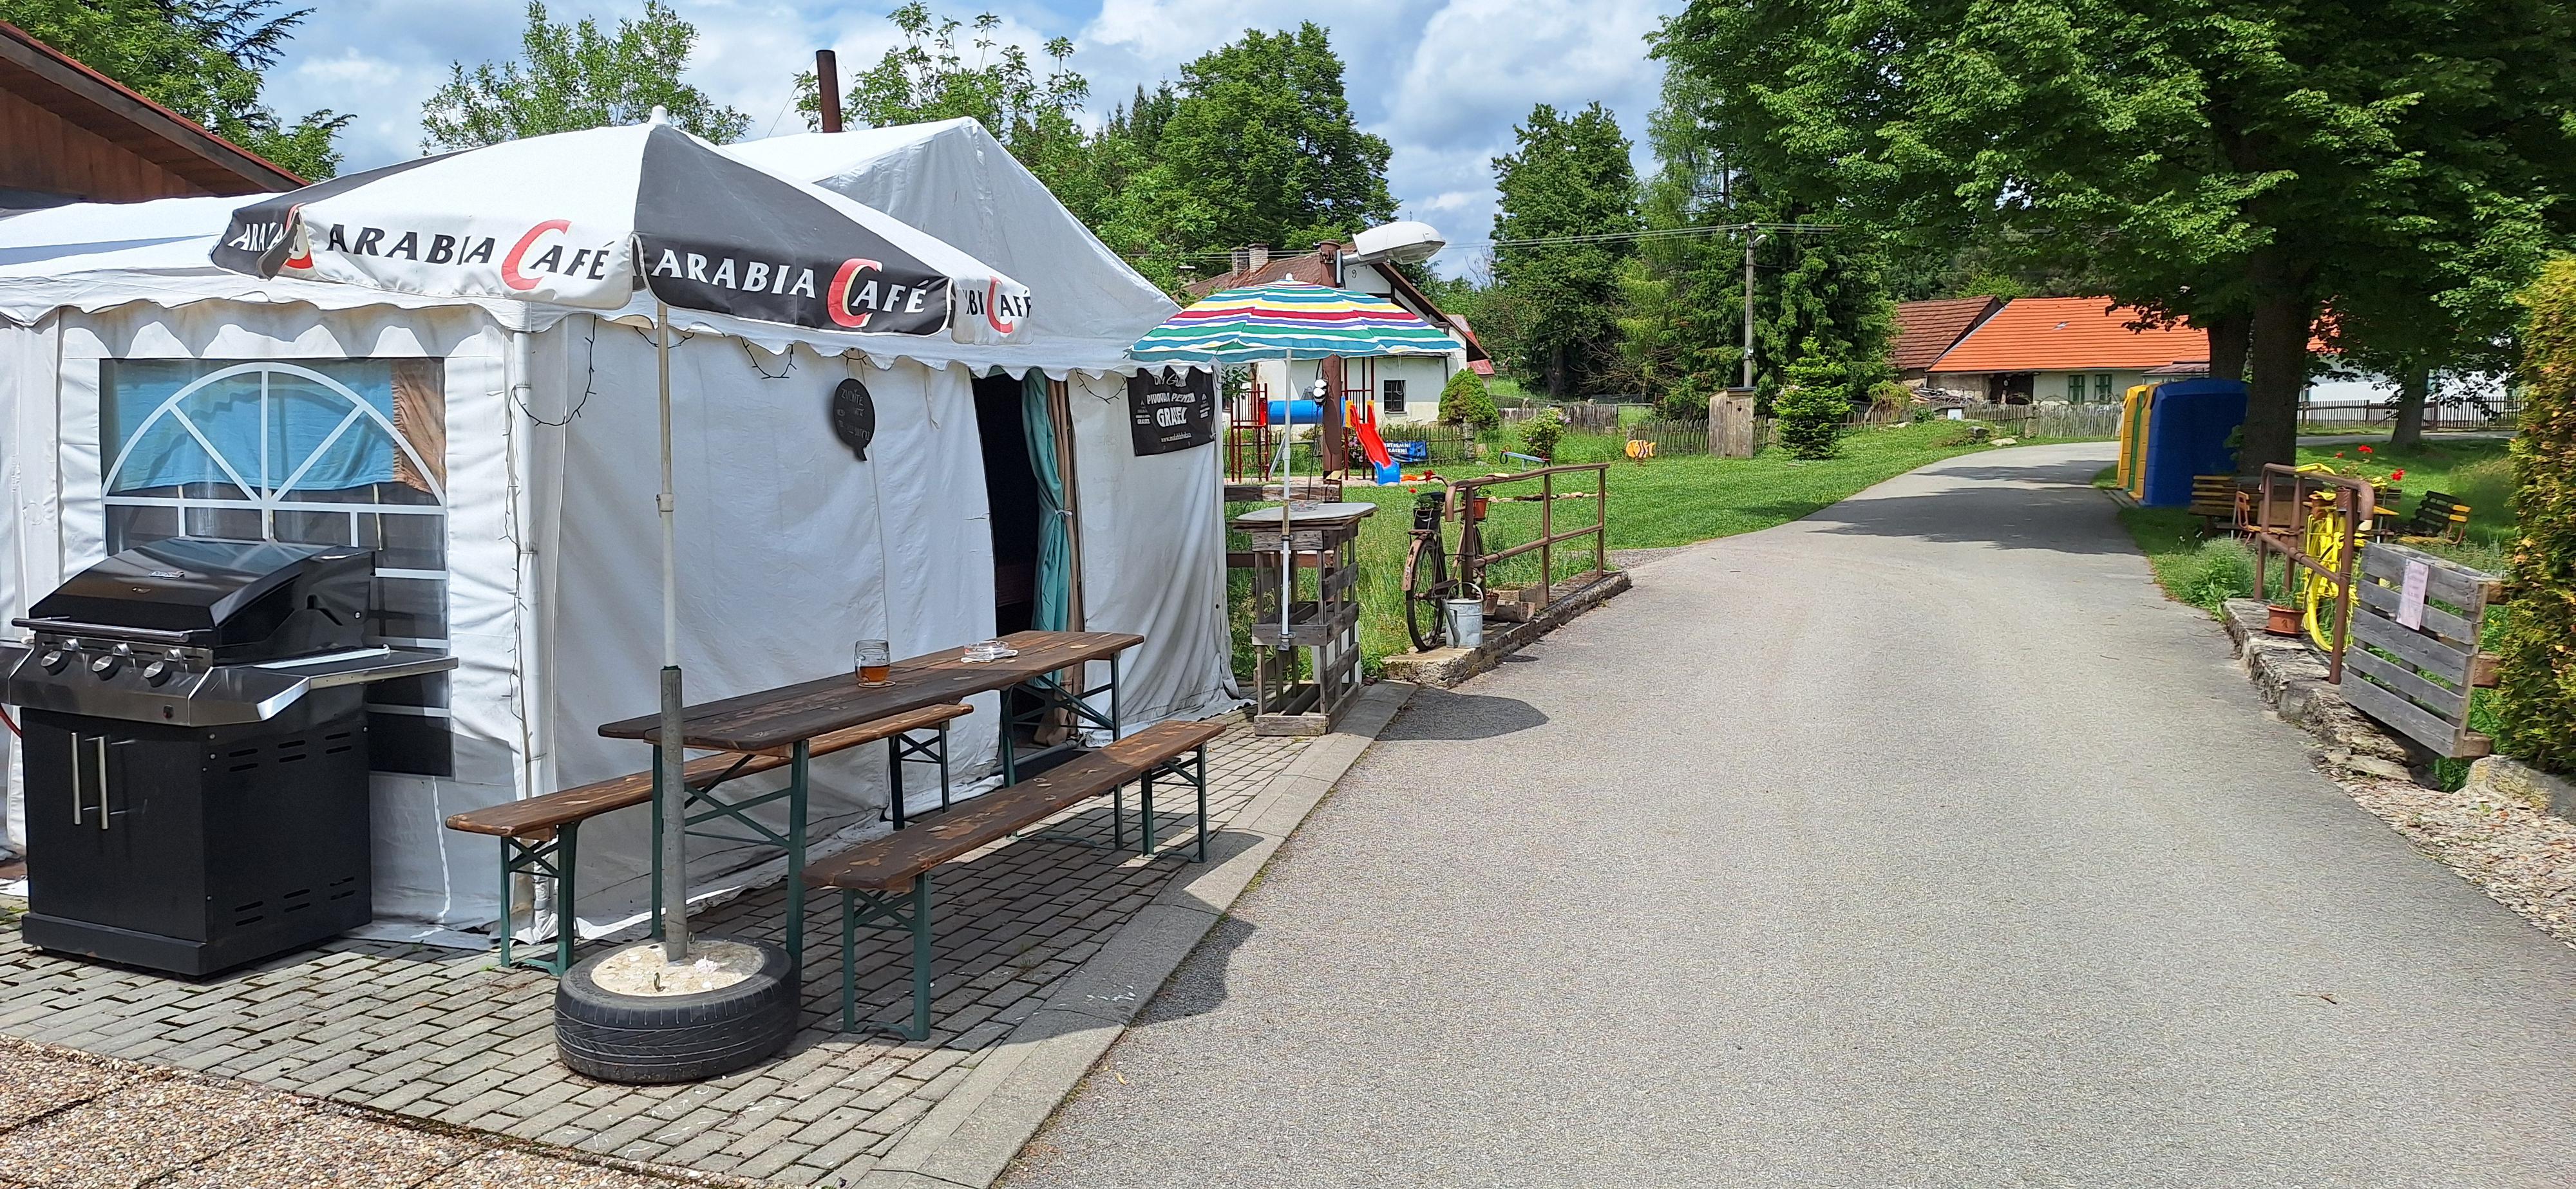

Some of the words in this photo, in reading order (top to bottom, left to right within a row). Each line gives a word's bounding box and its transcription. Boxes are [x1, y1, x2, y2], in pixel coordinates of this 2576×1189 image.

[326, 223, 496, 266] ARABIA
[500, 219, 615, 291] CAFÉ
[650, 248, 817, 299] ARABIA
[827, 258, 930, 328] CAFÉ
